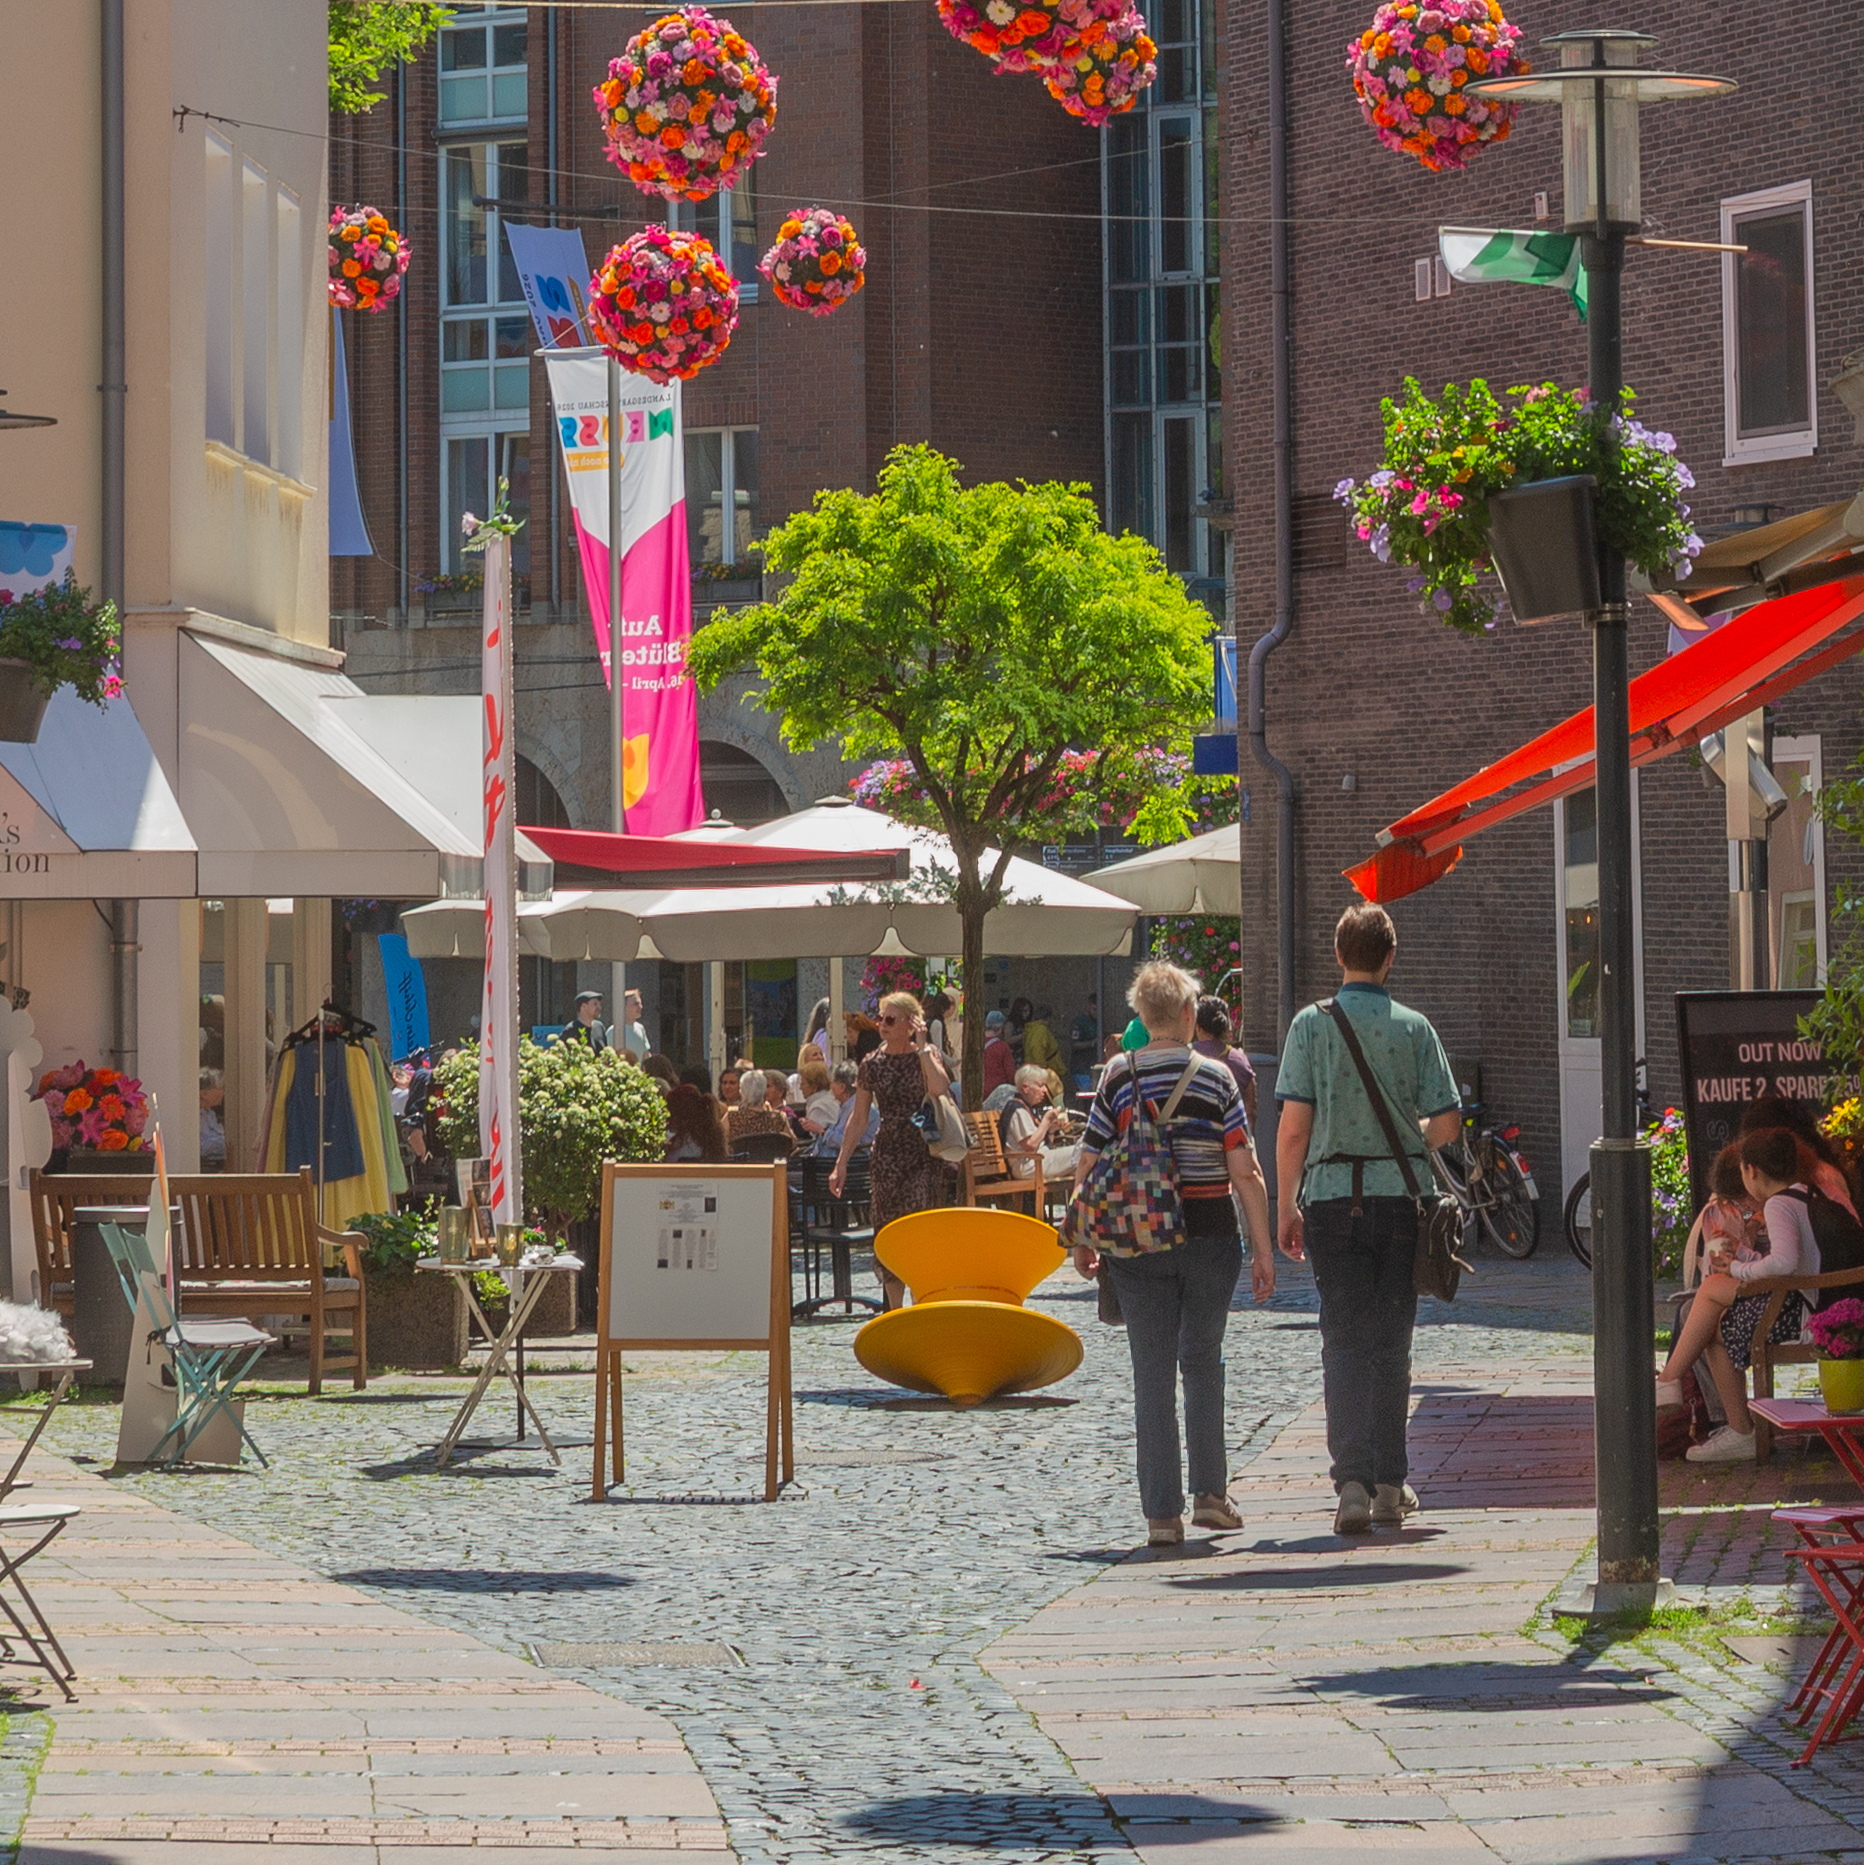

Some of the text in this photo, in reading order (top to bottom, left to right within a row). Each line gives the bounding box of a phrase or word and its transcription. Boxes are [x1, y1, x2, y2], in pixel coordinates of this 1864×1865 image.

[1738, 1041, 1822, 1063] OUT NOW
[1697, 1077, 1752, 1103] KAUFE
[1775, 1074, 1826, 1100] SPARE
